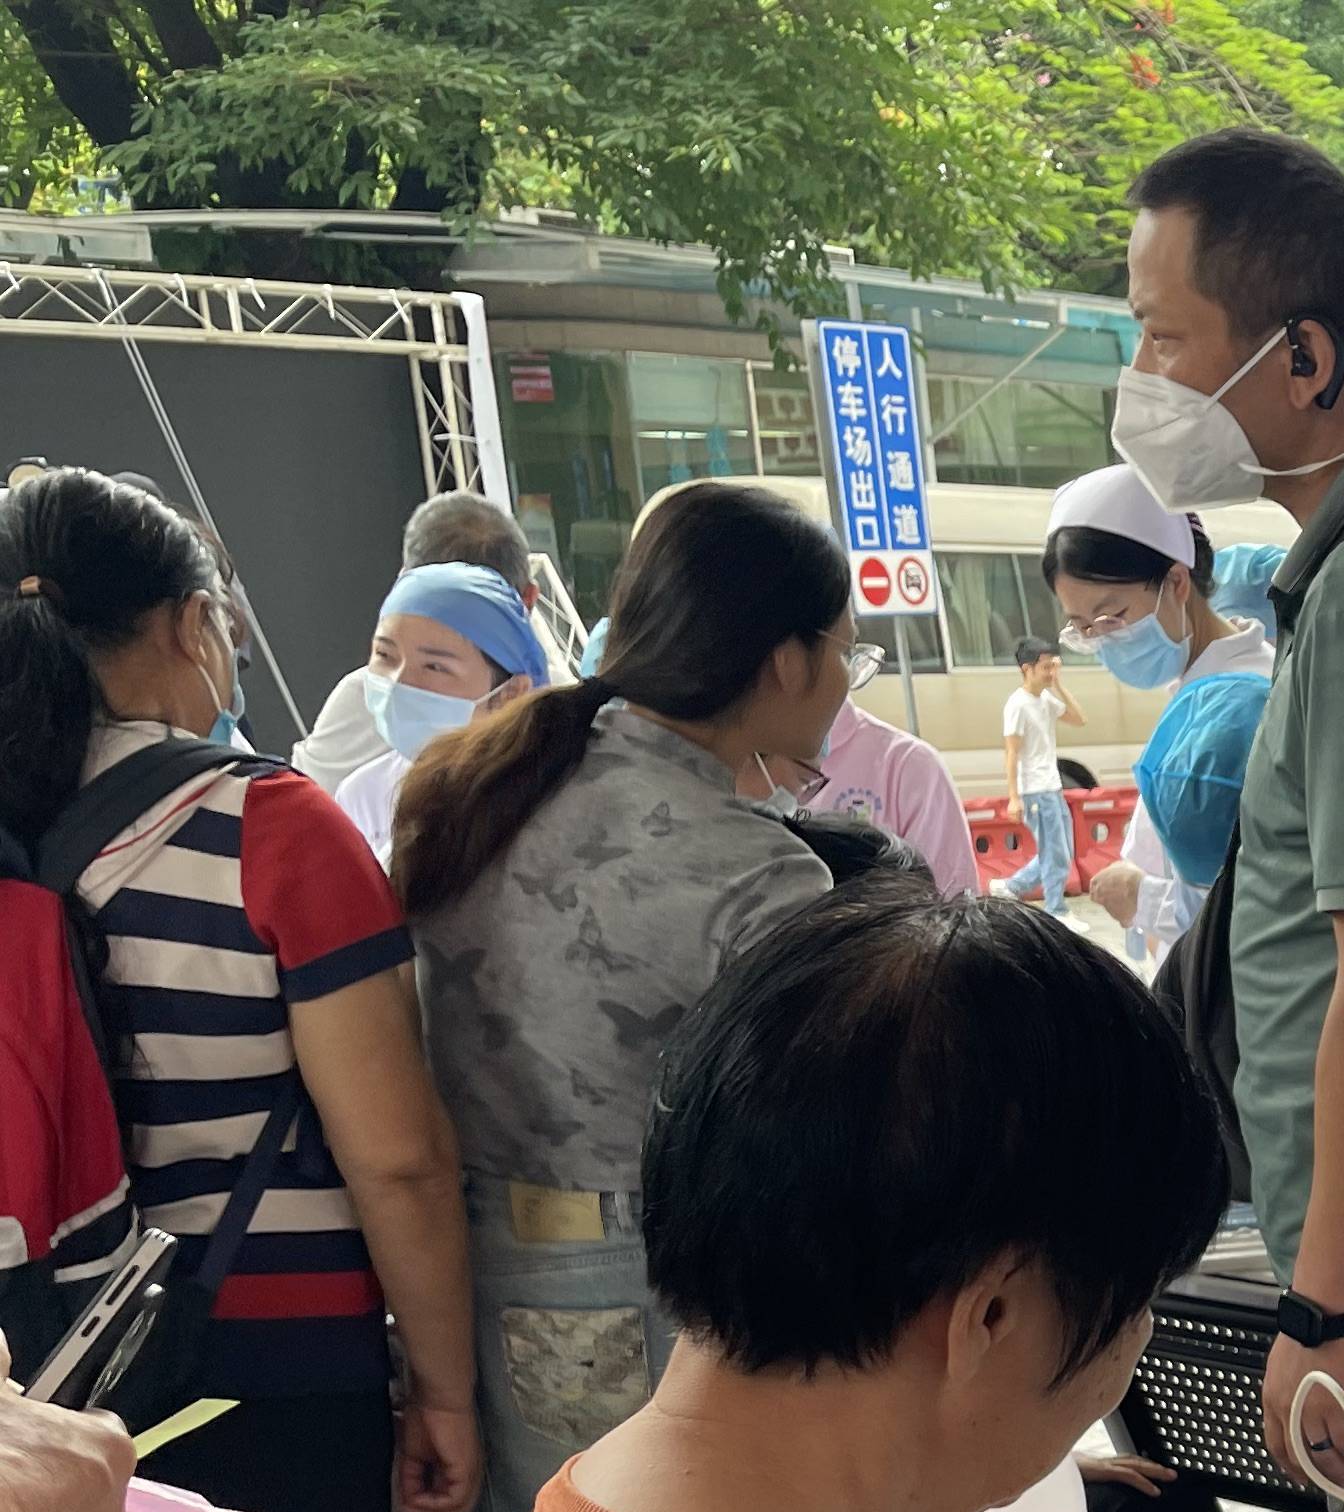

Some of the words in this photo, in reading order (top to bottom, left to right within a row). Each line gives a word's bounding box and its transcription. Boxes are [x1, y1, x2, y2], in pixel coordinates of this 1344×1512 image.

[832, 335, 880, 547] 停车场出口
[876, 337, 921, 545] 人行通道
